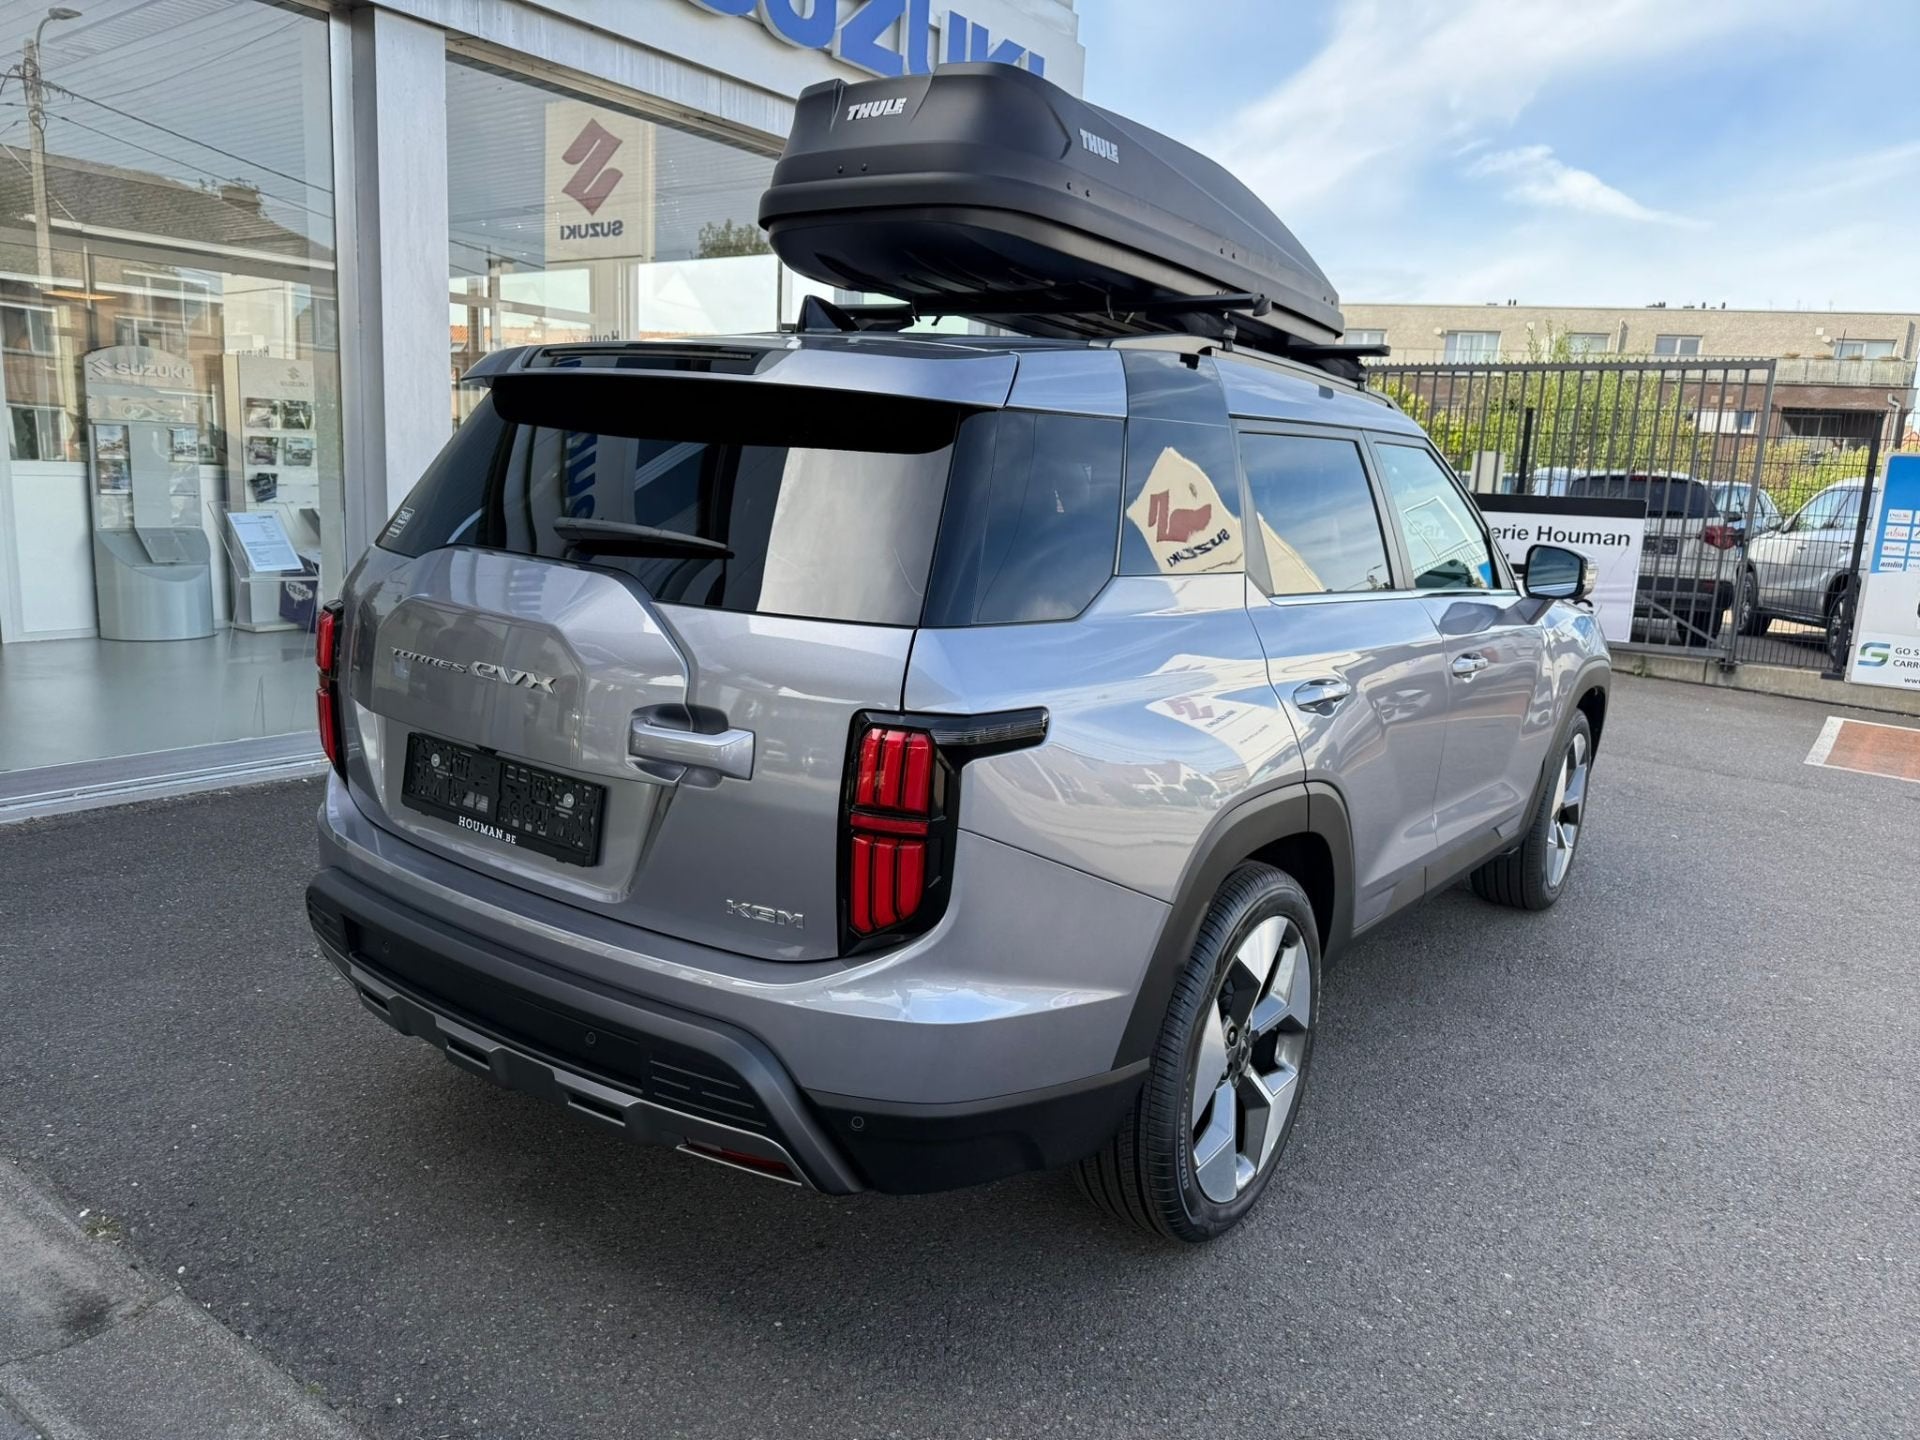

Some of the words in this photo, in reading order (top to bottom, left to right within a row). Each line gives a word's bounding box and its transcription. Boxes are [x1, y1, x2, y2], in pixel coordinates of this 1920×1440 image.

[847, 97, 907, 121] THULE
[1079, 127, 1119, 164] THULE
[115, 362, 188, 379] SUZUKI
[1491, 524, 1529, 541] erie
[1536, 526, 1631, 546] Houman
[391, 646, 467, 673] TORRES
[1895, 647, 1911, 656] GO
[457, 815, 517, 845] HOUMAN.BE
[726, 899, 805, 929] KGM
